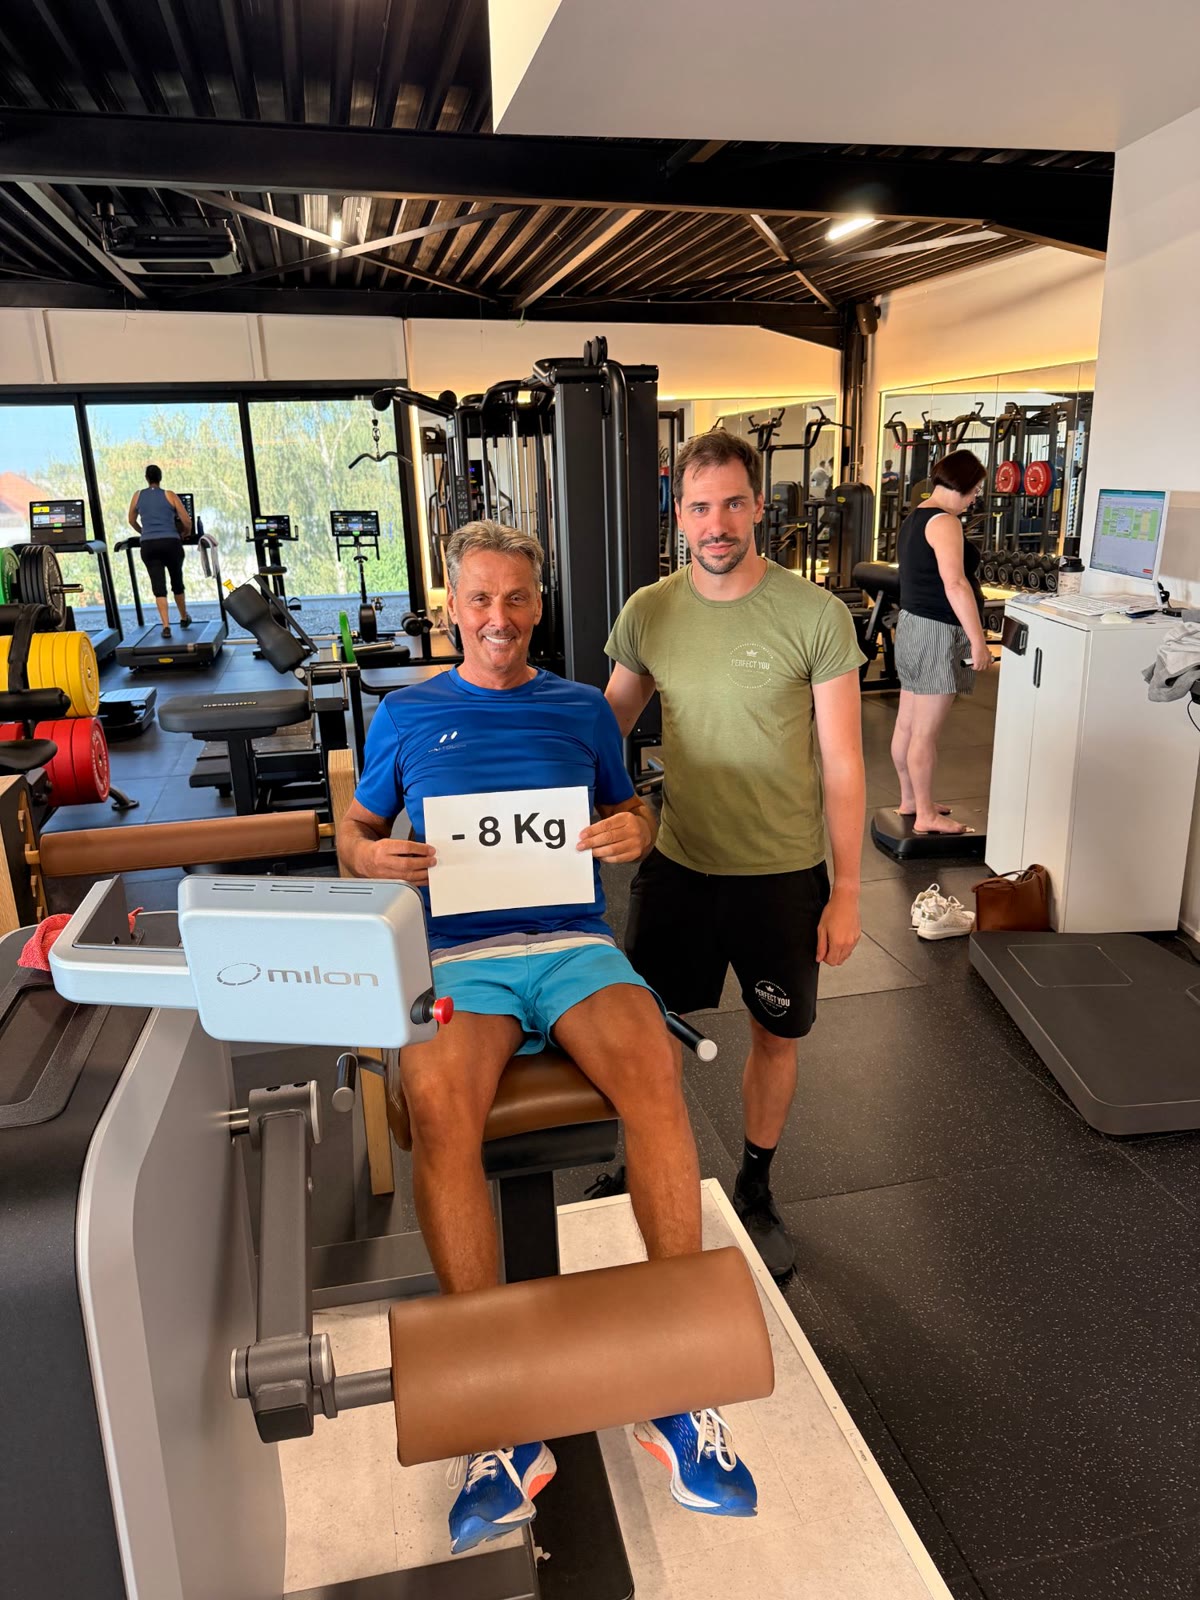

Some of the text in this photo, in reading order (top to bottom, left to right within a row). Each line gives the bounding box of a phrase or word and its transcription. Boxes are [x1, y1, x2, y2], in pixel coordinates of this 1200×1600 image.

[758, 661, 770, 670] YOU
[479, 816, 501, 847] 8
[514, 812, 566, 849] Kg
[267, 965, 379, 987] milon
[755, 987, 777, 1004] PERFECT
[777, 996, 790, 1007] YOU
